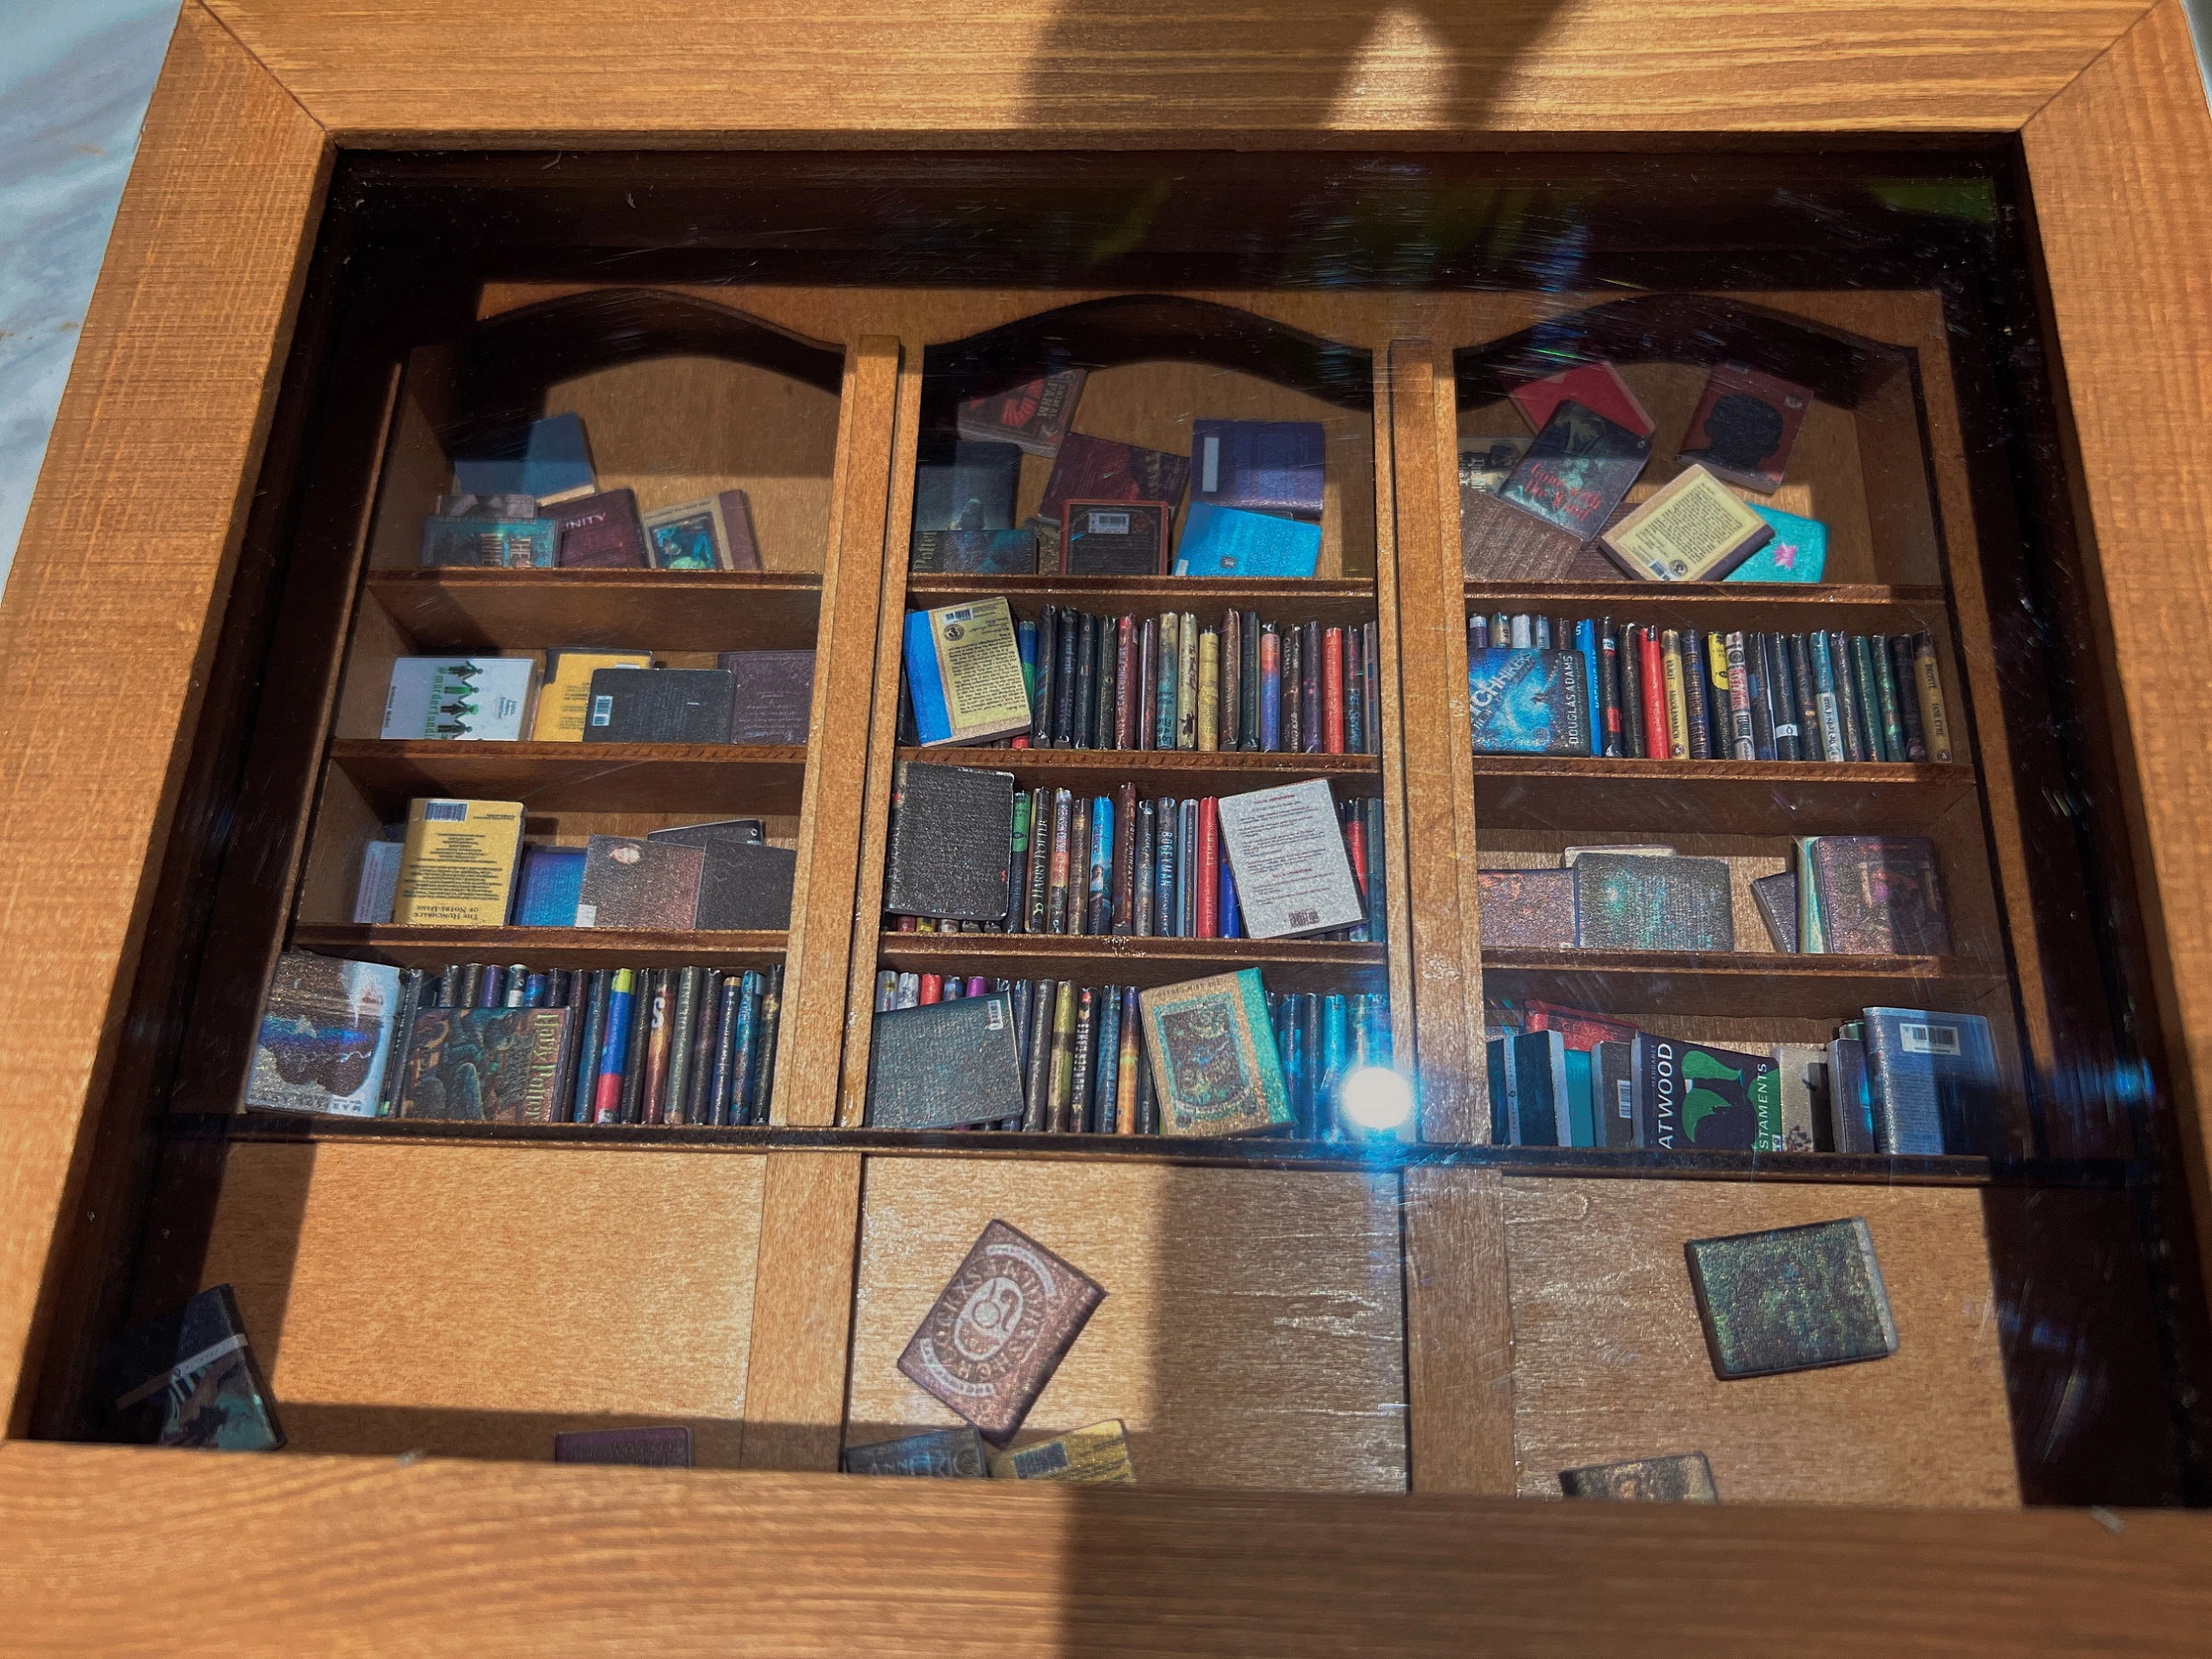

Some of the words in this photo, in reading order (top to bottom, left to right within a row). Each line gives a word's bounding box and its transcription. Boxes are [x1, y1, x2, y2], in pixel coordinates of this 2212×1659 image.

[1037, 381, 1057, 419] FARM
[1563, 654, 1576, 692] ADAMS
[1565, 693, 1579, 744] DOUGLAS
[1034, 819, 1048, 859] POTTER
[1160, 831, 1172, 886] BOGEYMAN
[1032, 860, 1046, 898] HARRY
[1658, 1043, 1674, 1150] ATWOOD
[1757, 1062, 1770, 1150] STAMENTS
